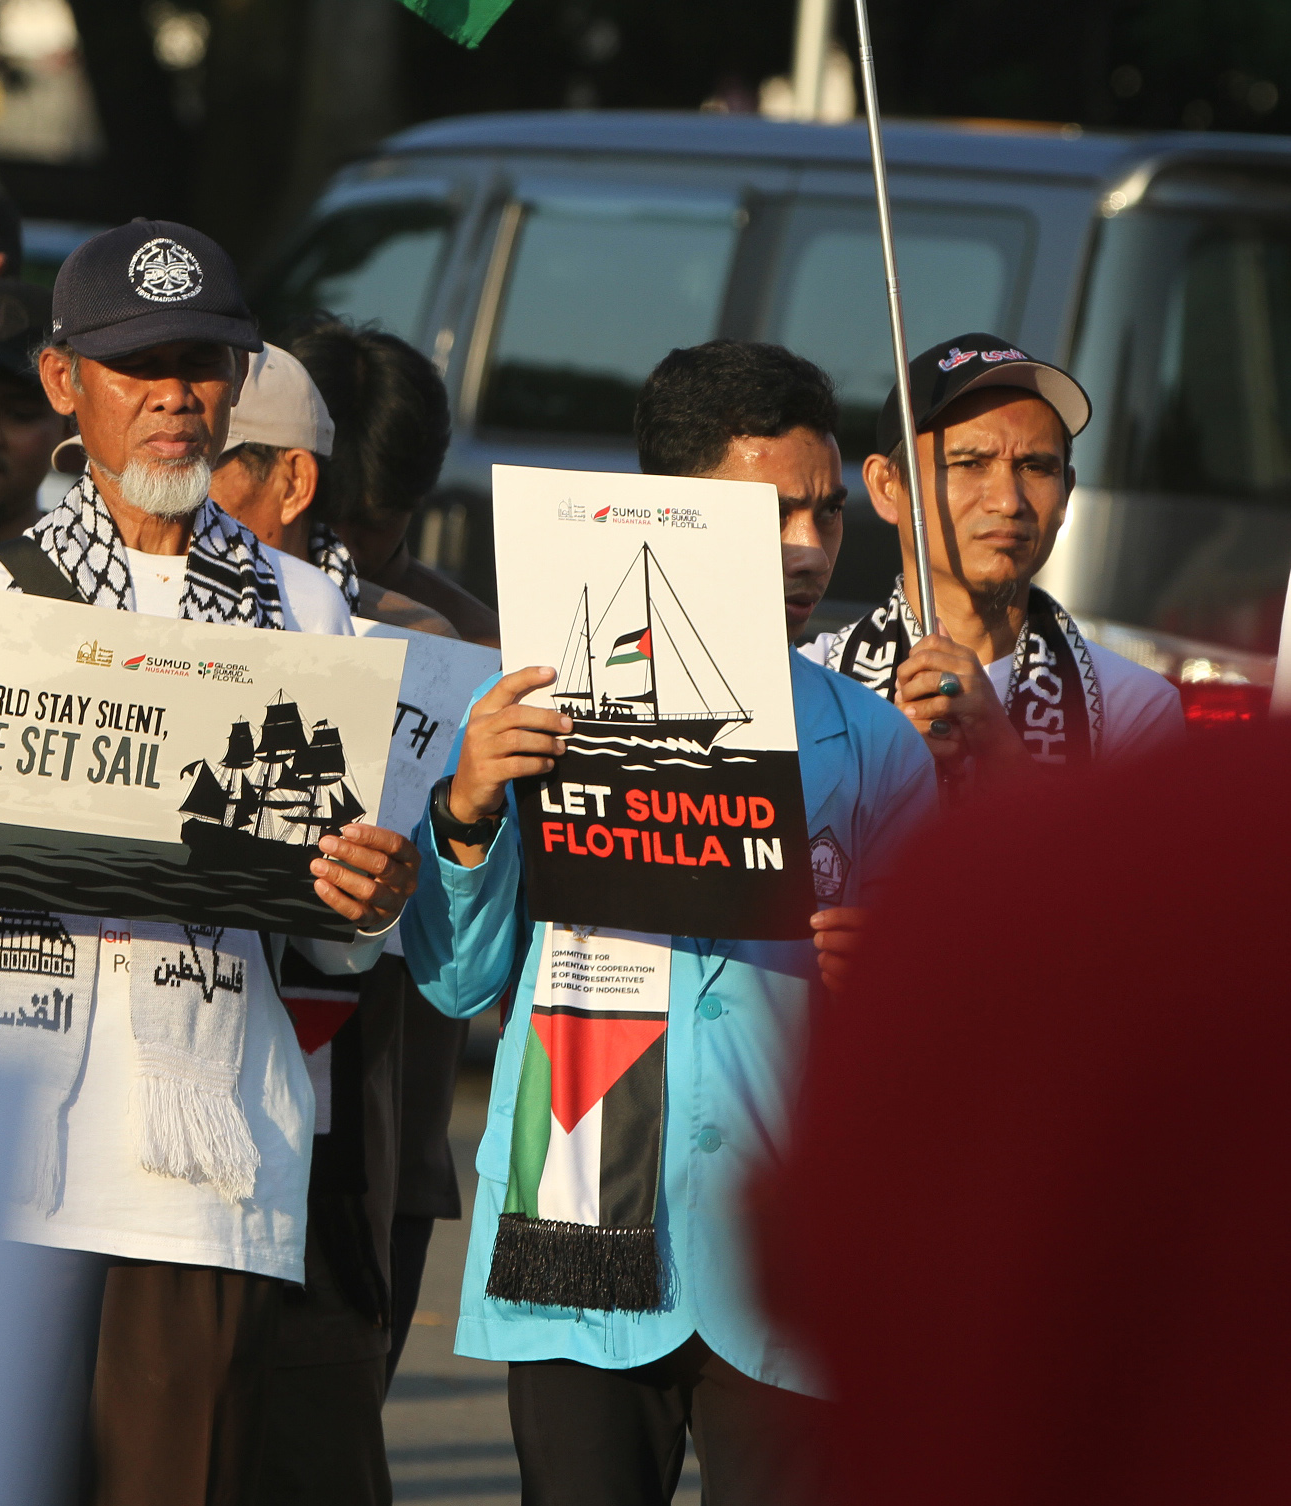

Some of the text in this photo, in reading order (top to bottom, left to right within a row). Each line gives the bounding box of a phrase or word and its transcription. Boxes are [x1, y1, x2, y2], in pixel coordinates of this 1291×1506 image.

[612, 507, 652, 518] SUMUD
[671, 507, 702, 516] GLOBAL
[612, 517, 652, 526] NUSANTARA
[671, 514, 697, 522] SUMUD
[671, 520, 708, 530] FLOTILLA
[145, 656, 192, 670] SUMUD
[213, 662, 250, 672] GLOBAL
[144, 666, 190, 677] NUSANTARA
[213, 668, 243, 678] SUMUD
[212, 674, 254, 685] FLOTILLA
[35, 691, 92, 726] STAY
[95, 700, 169, 741] SILENT,
[16, 726, 81, 781] SET
[87, 735, 161, 790] SAIL
[540, 781, 775, 829] LET SUMUD
[542, 821, 731, 867] FLOTILLA
[743, 837, 784, 871] IN
[595, 953, 610, 961] FOR
[154, 951, 244, 994] فلسطين
[596, 965, 655, 973] COOPERATION
[571, 972, 645, 984] REPRESENTATIVES
[595, 986, 640, 994] INDONESIA
